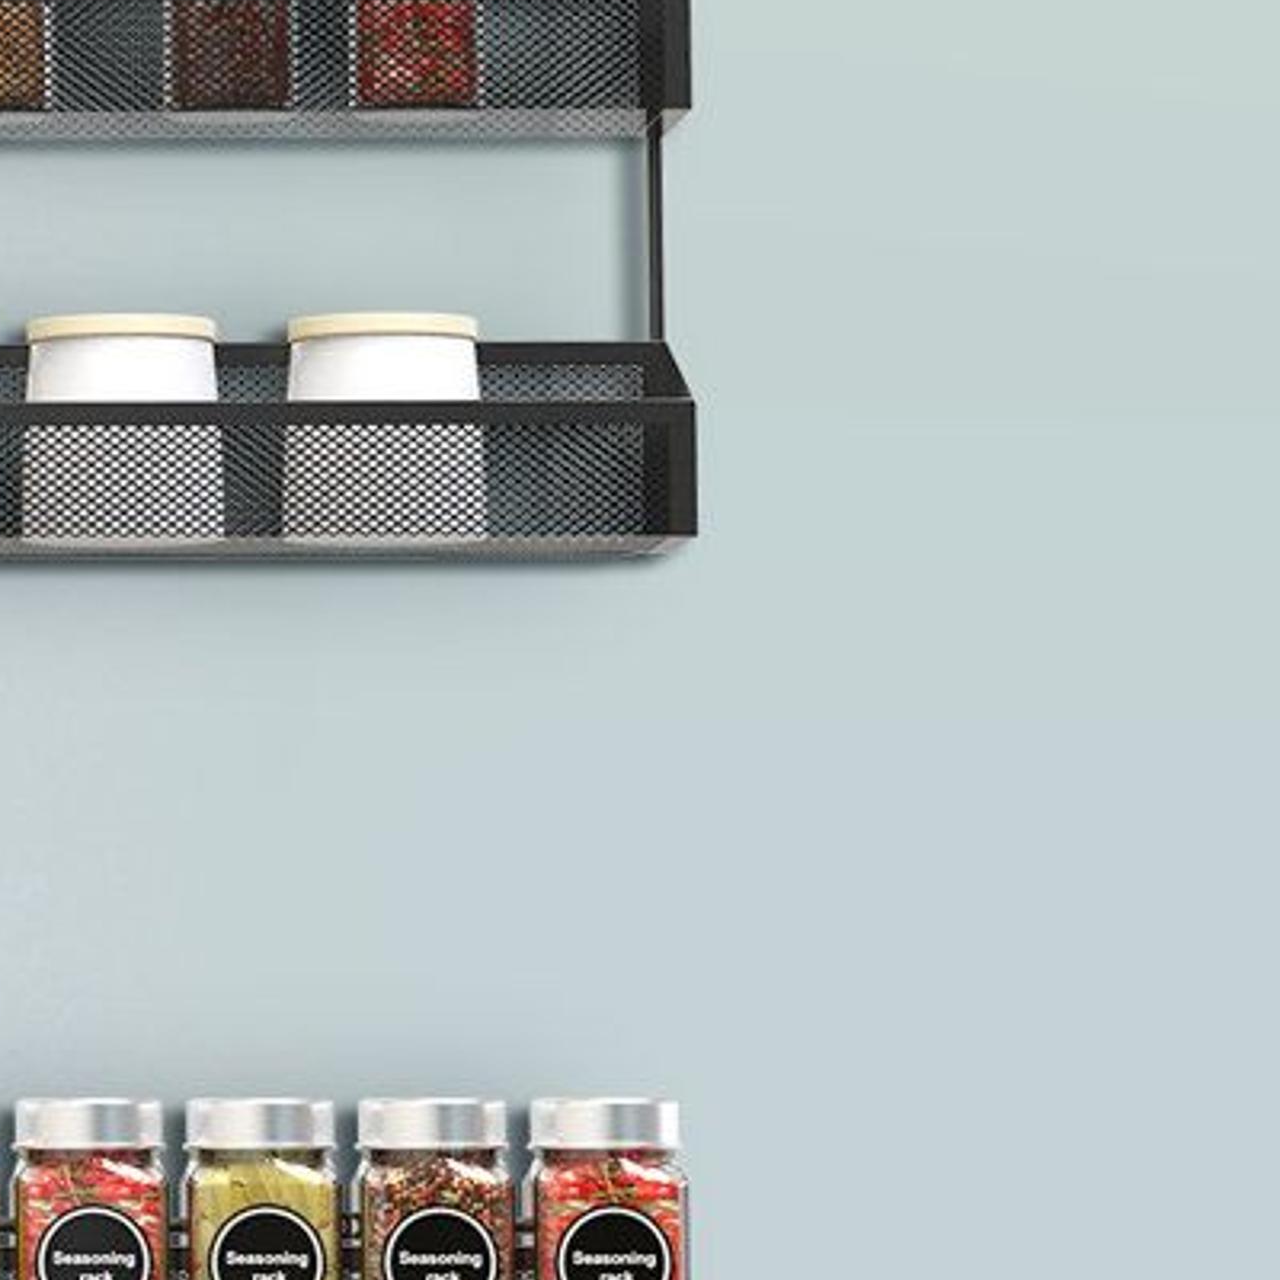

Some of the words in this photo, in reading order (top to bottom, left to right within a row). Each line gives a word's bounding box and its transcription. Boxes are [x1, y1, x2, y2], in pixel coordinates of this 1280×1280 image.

[52, 1250, 136, 1269] Seasoning
[226, 1250, 309, 1269] Seasoning
[399, 1250, 483, 1269] Seasoning
[572, 1250, 657, 1269] Seasoning
